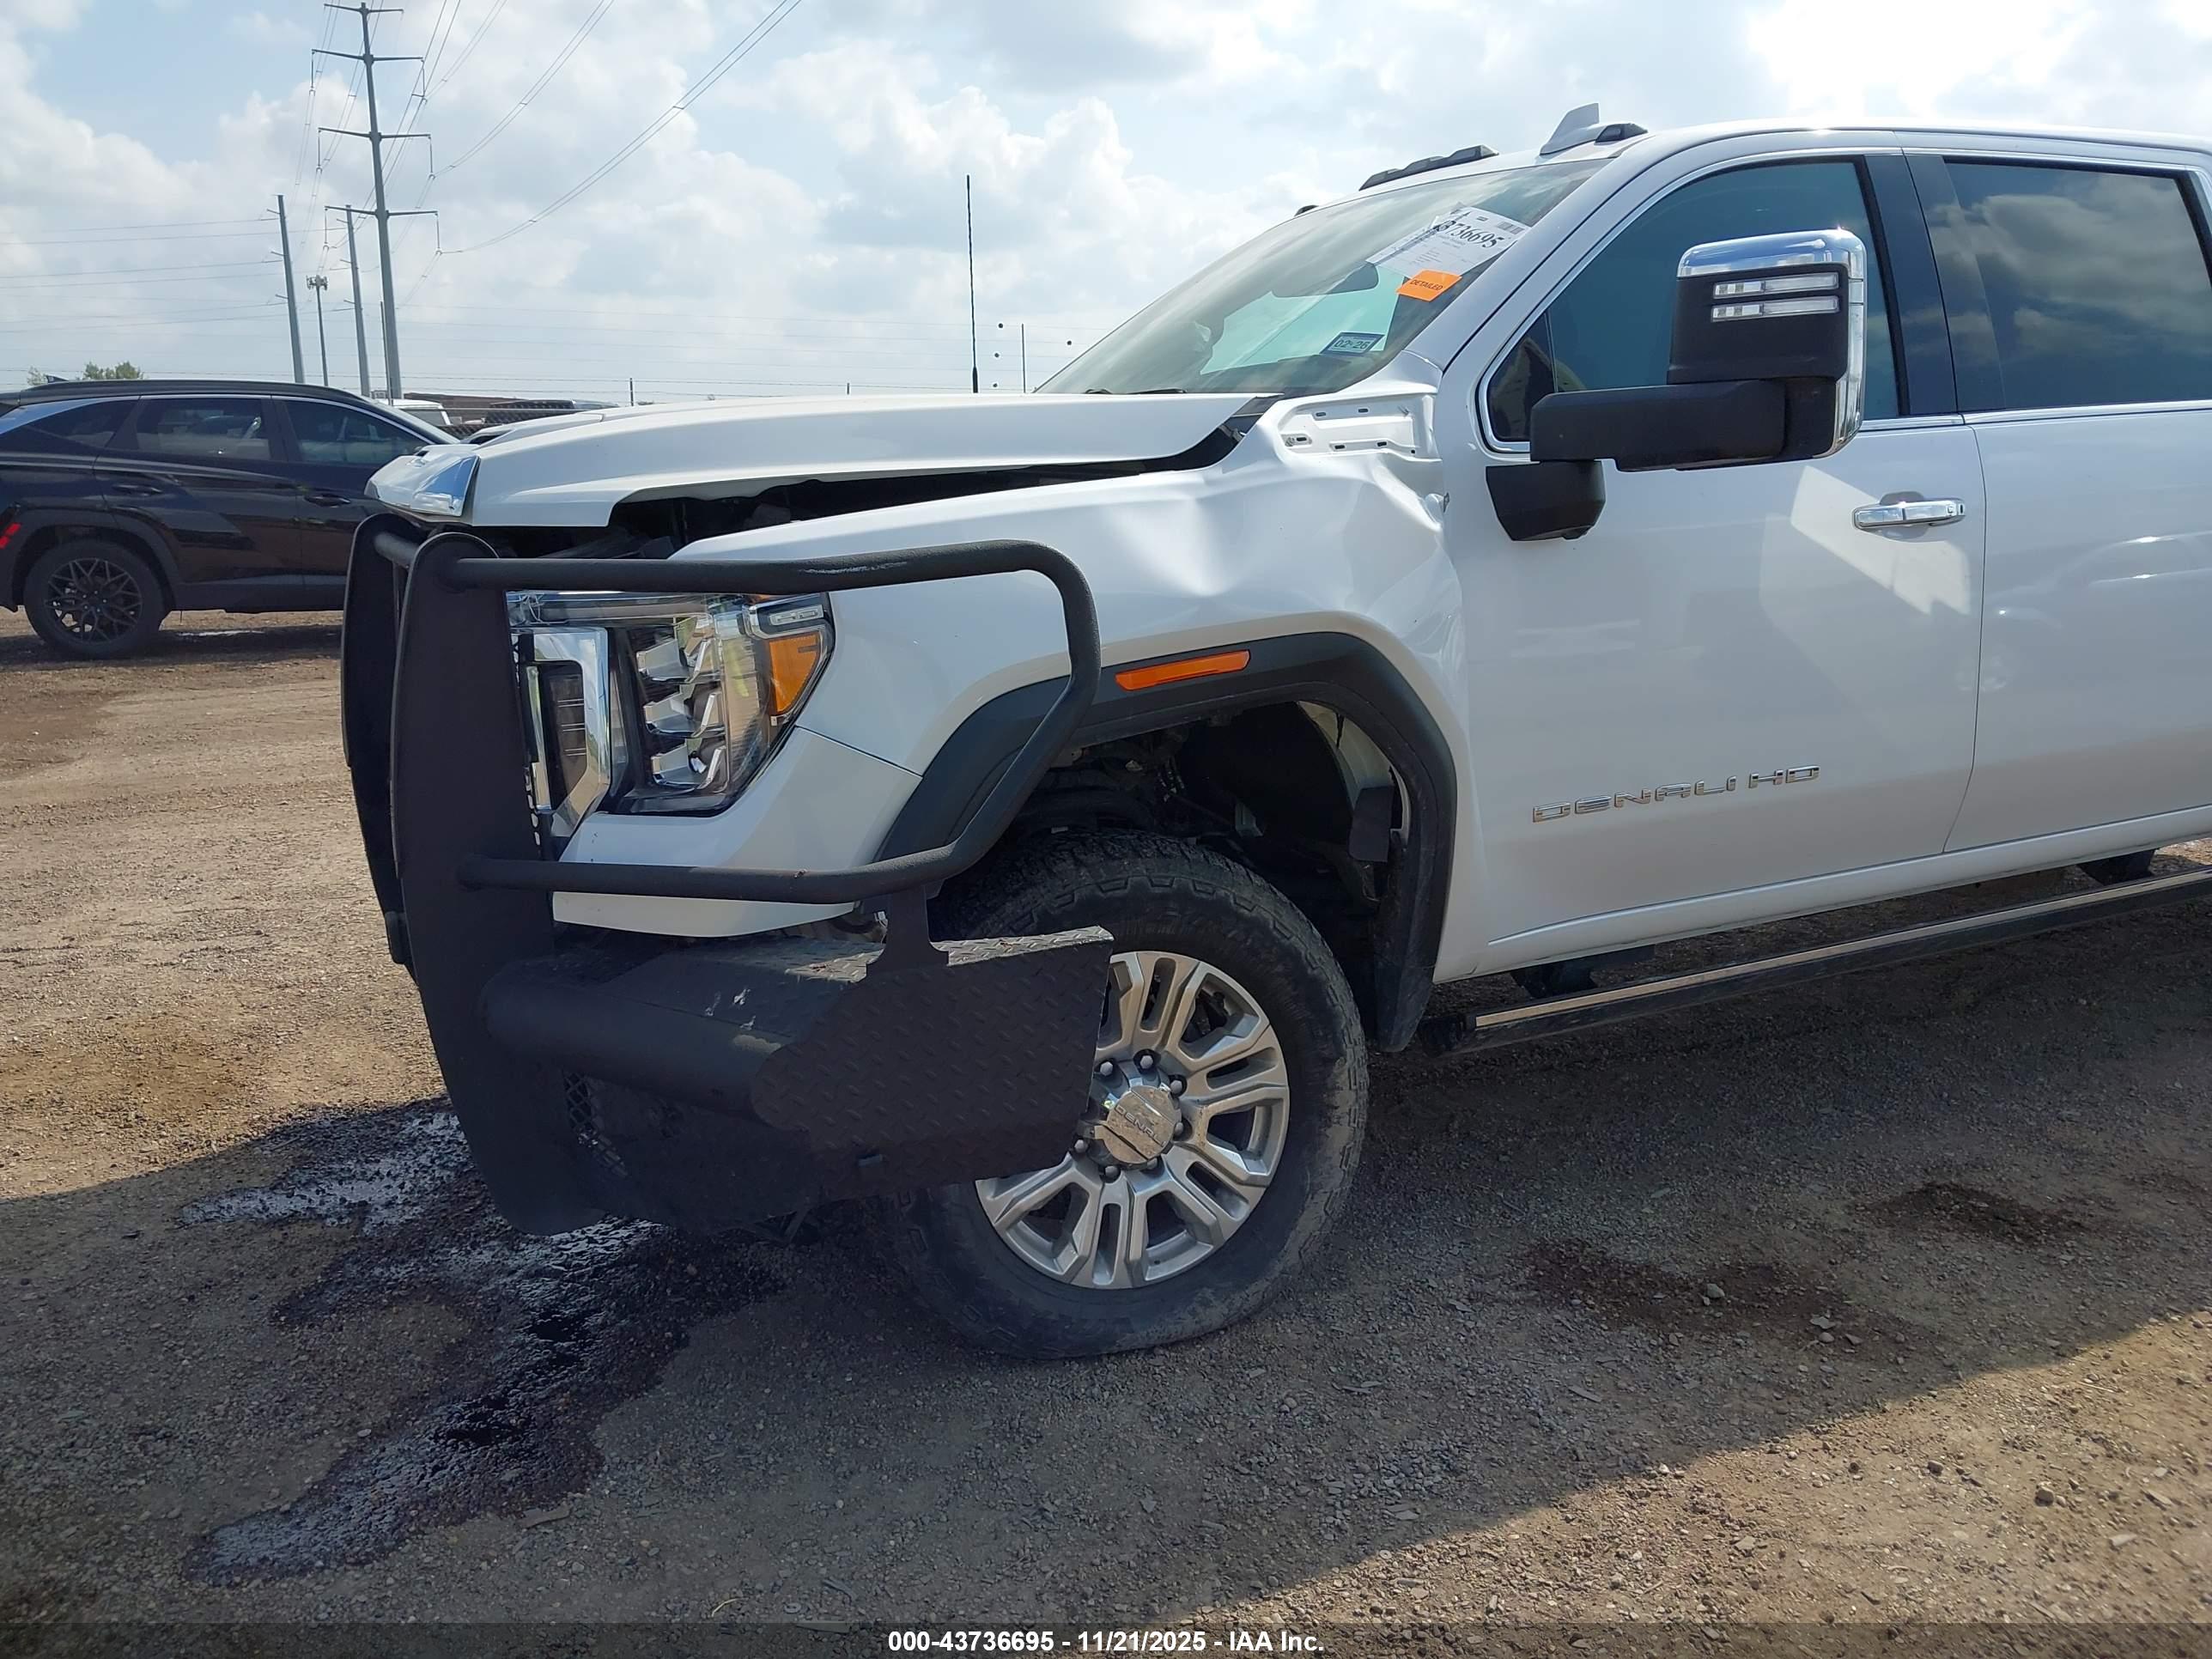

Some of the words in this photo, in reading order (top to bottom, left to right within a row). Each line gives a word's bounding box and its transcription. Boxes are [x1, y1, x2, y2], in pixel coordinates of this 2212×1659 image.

[1409, 278, 1443, 291] DETAILED
[1533, 775, 1736, 823] DENALI
[1747, 764, 1821, 789] HD
[1115, 1105, 1167, 1148] DENALI
